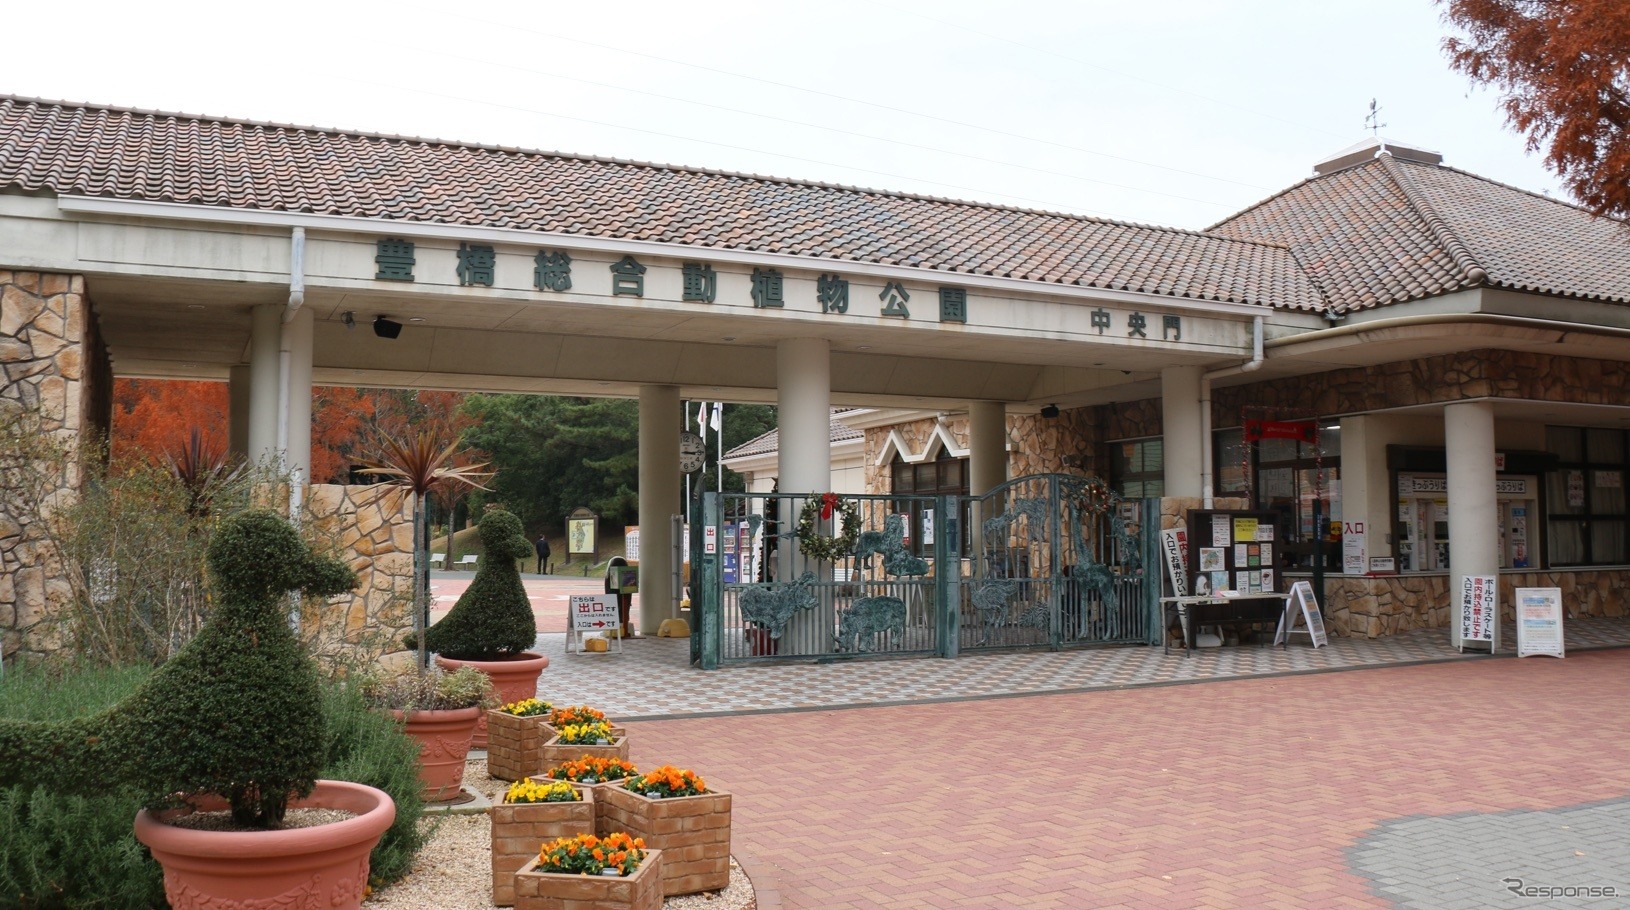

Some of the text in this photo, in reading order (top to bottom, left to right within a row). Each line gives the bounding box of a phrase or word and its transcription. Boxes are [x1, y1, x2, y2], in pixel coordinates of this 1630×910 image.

[375, 238, 967, 324] 豊橋総合動植物公園
[1090, 307, 1181, 341] 中央門
[707, 528, 714, 551] 出口
[1344, 522, 1364, 534] 入口
[1472, 578, 1483, 638] 園内持込禁止です
